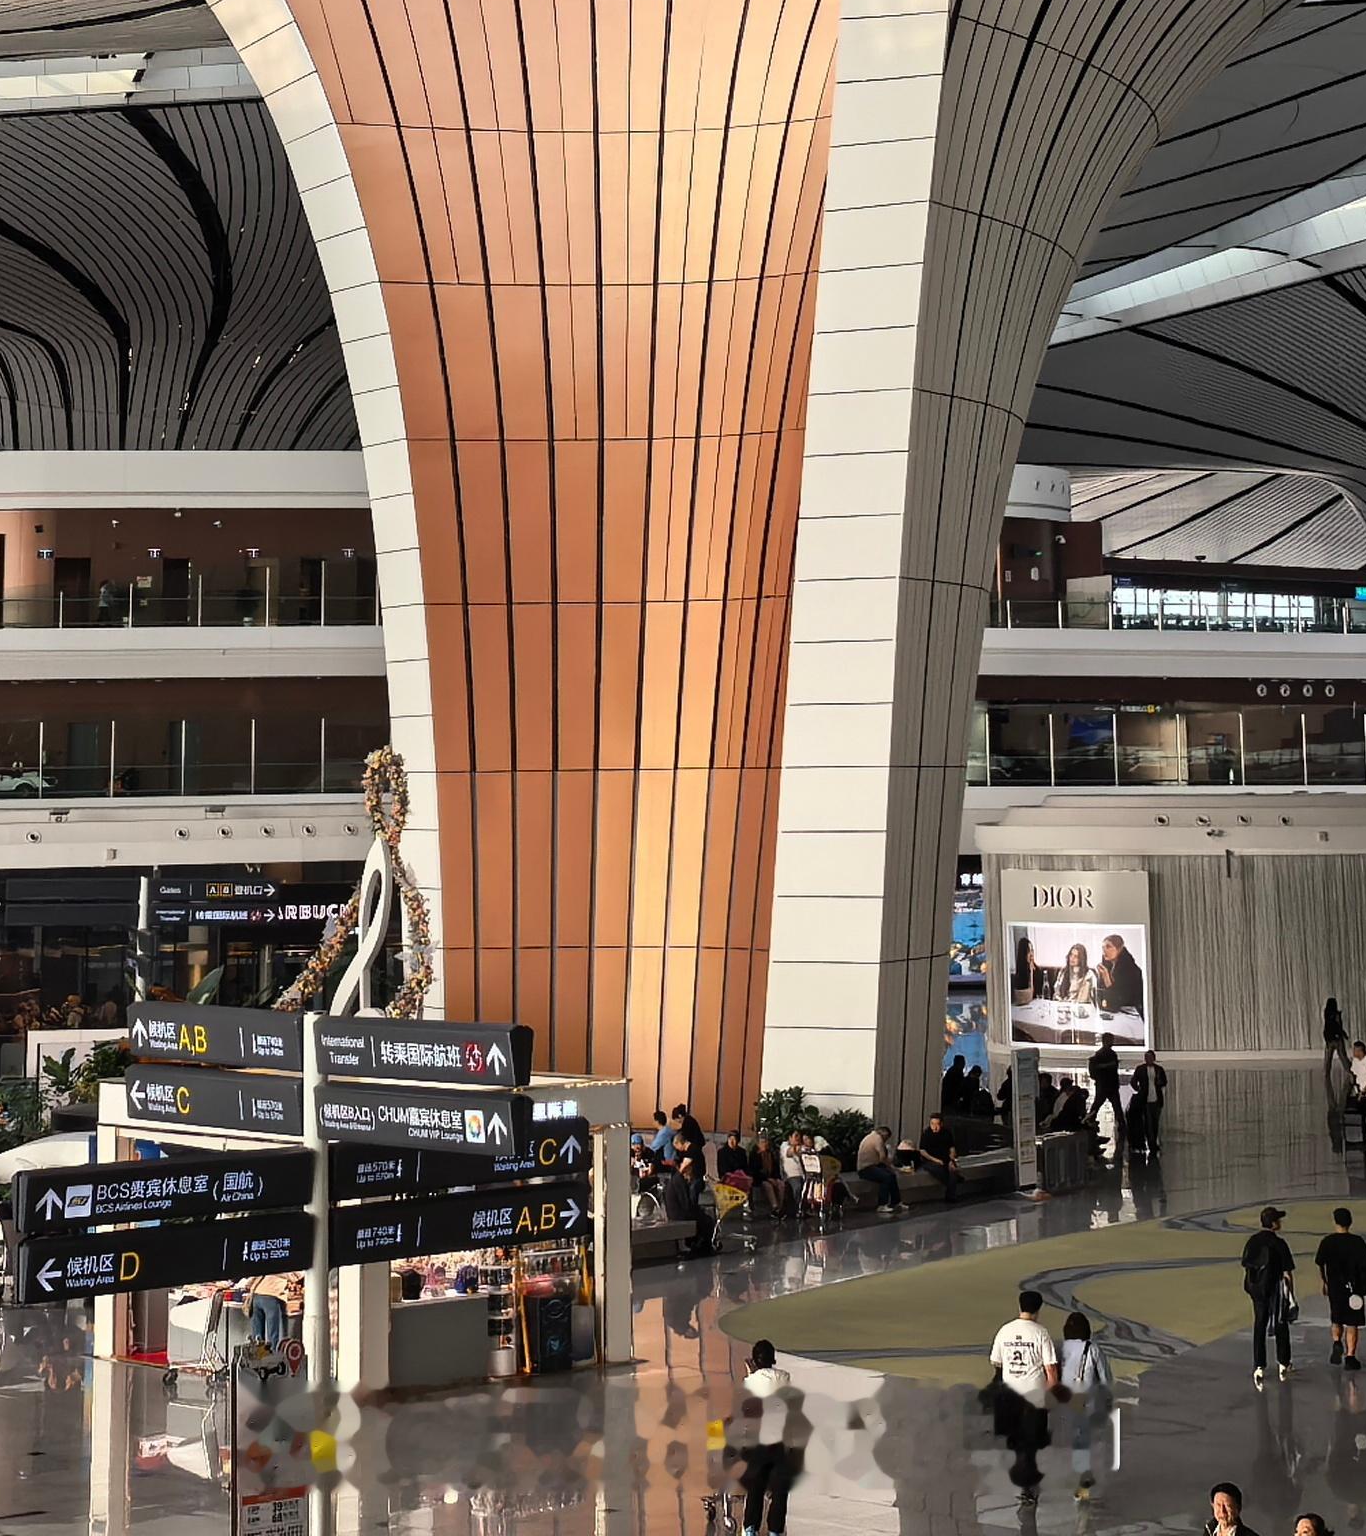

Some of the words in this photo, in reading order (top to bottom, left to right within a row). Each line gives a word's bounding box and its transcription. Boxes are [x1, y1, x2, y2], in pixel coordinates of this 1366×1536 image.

[1033, 885, 1093, 908] DIOR
[148, 1020, 176, 1040] 候机区
[179, 1024, 208, 1056] A,B
[321, 1034, 365, 1048] International
[329, 1051, 360, 1065] Transfer
[380, 1040, 462, 1068] 转乘国际航班
[146, 1083, 175, 1102] 候机区
[176, 1086, 190, 1114] C
[408, 1127, 428, 1139] CHUM
[429, 1129, 439, 1140] VIP
[441, 1129, 464, 1143] Lounge
[539, 1138, 557, 1165] C
[356, 1174, 368, 1184] Up
[96, 1174, 209, 1201] BCS贵宾休息室
[221, 1193, 232, 1203] Air
[233, 1191, 254, 1202] China
[96, 1203, 113, 1214] BCS
[114, 1200, 142, 1212] Airlines
[143, 1198, 172, 1212] Lounge
[472, 1207, 513, 1227] 候机区
[515, 1203, 556, 1235] A,B
[471, 1228, 496, 1240] Waiting
[497, 1227, 513, 1237] Area
[356, 1239, 367, 1249] Up
[250, 1252, 261, 1262] Up
[270, 1250, 289, 1259] 520m
[66, 1253, 115, 1277] 候机区
[120, 1252, 140, 1281] D
[65, 1275, 95, 1289] Waiting
[96, 1274, 115, 1285] Area
